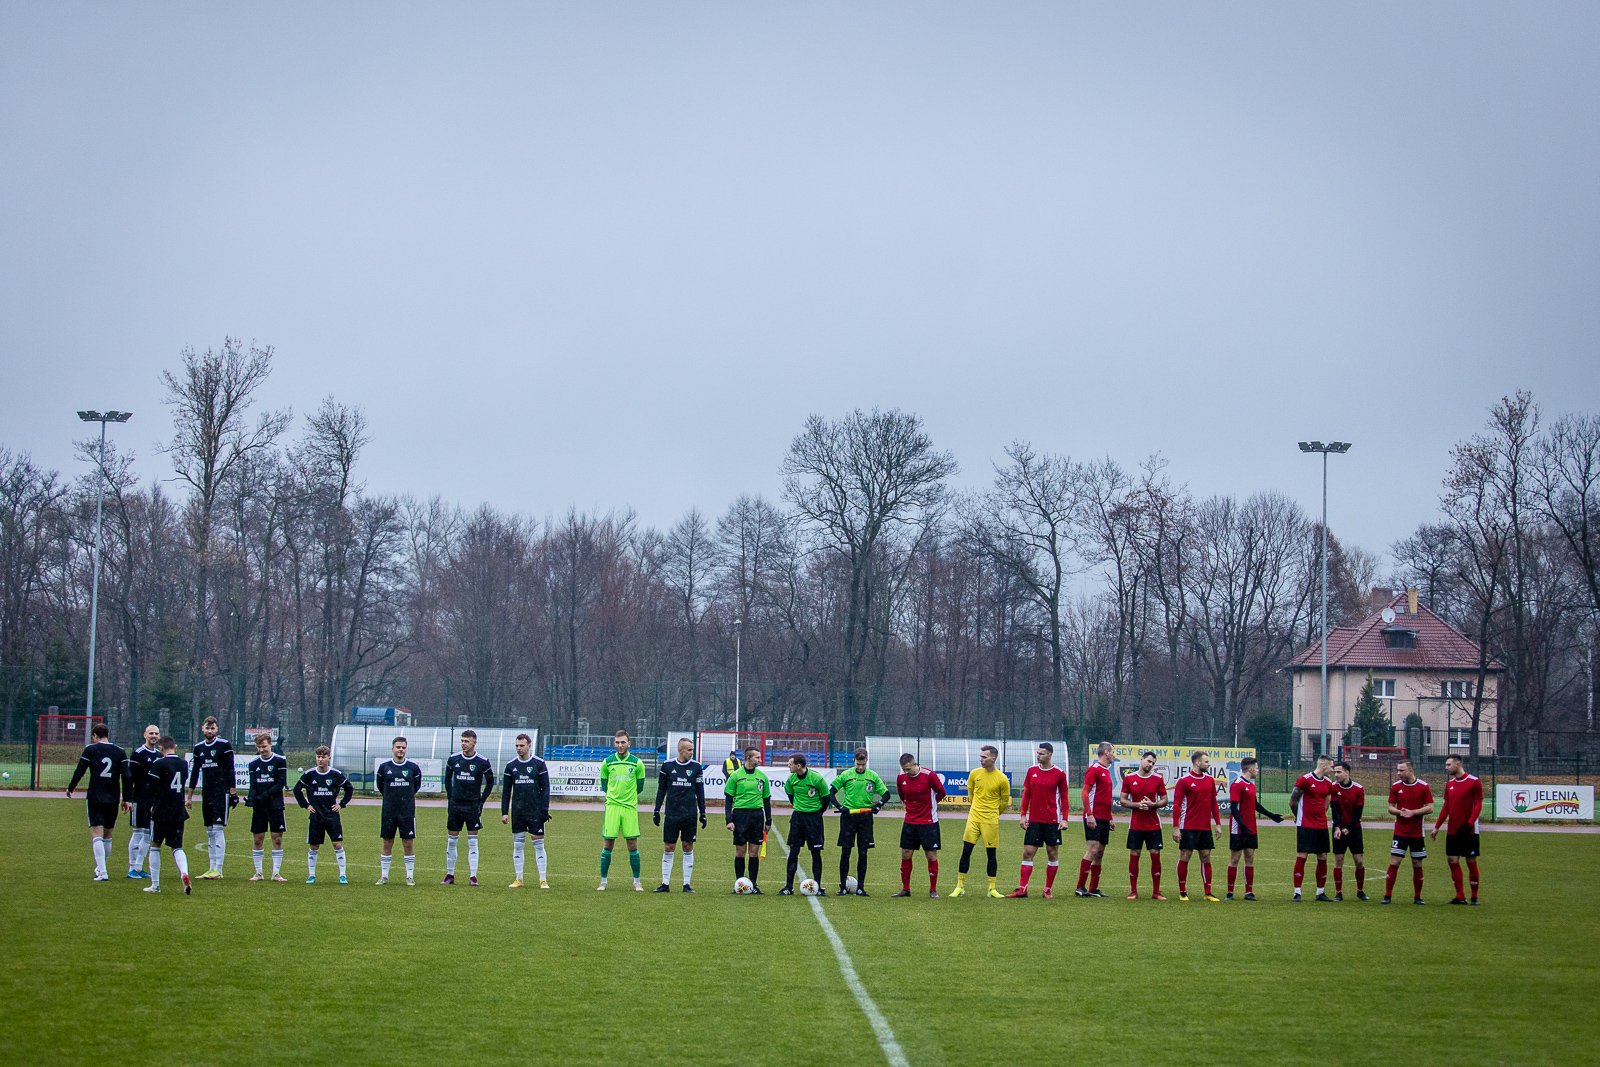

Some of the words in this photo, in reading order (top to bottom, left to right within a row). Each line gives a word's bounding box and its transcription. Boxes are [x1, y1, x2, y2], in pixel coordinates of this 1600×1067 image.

[100, 757, 112, 778] 2
[170, 772, 182, 792] 4
[1534, 791, 1579, 802] JELENIA
